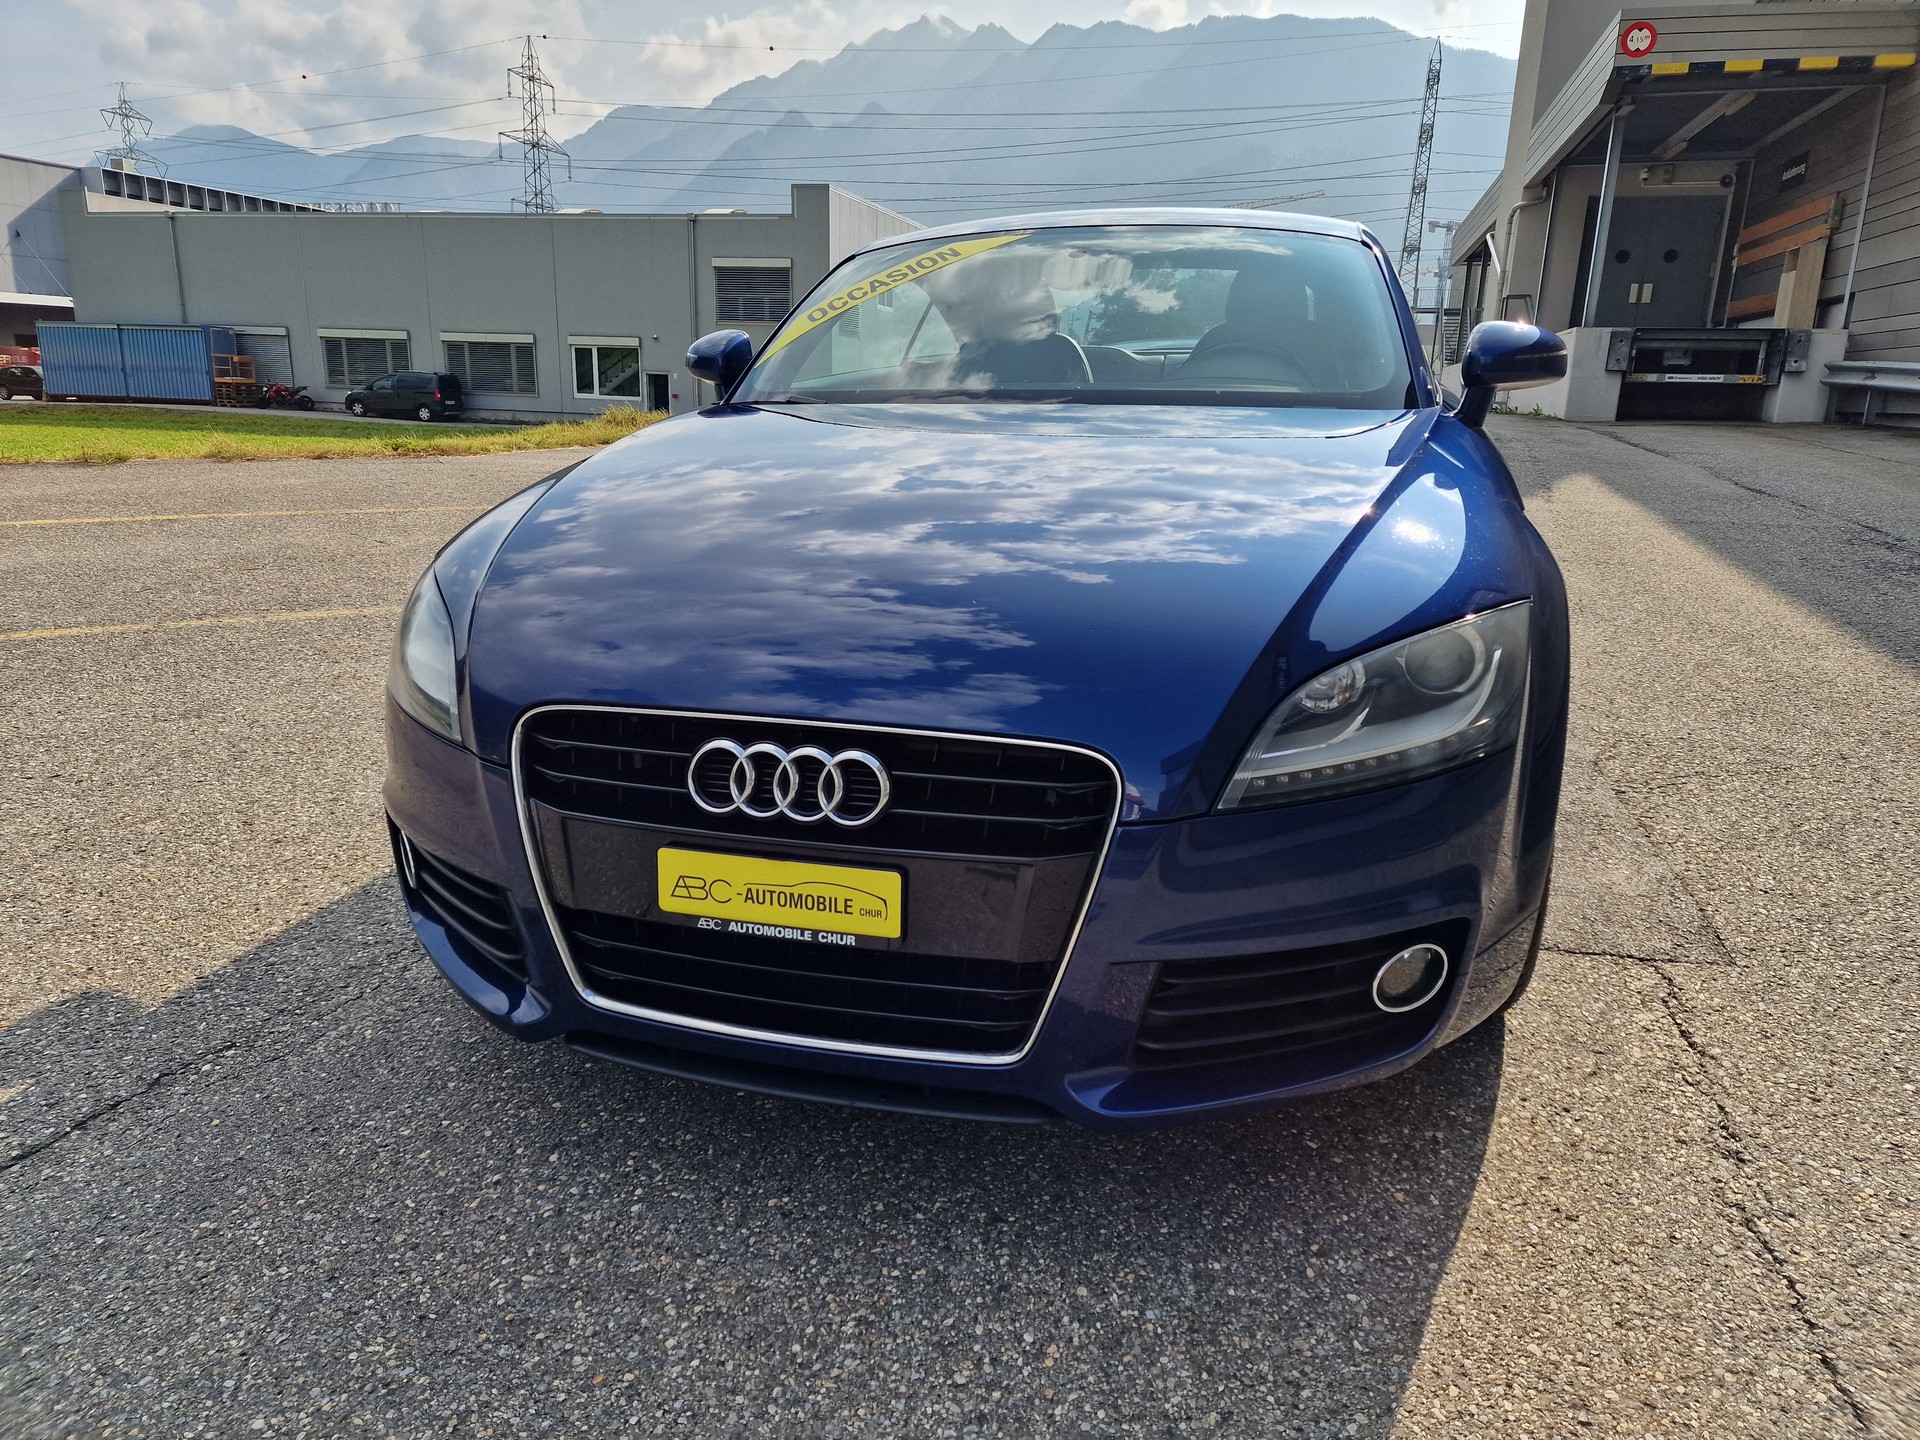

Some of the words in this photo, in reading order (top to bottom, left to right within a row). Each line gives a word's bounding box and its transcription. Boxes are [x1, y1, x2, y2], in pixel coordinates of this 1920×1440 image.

[807, 247, 962, 323] OCCASION
[671, 875, 732, 904] ABC
[859, 908, 883, 918] CHUR
[697, 917, 722, 931] ABC
[728, 921, 812, 941] AUTOMOBILE
[818, 932, 856, 946] CHUR
